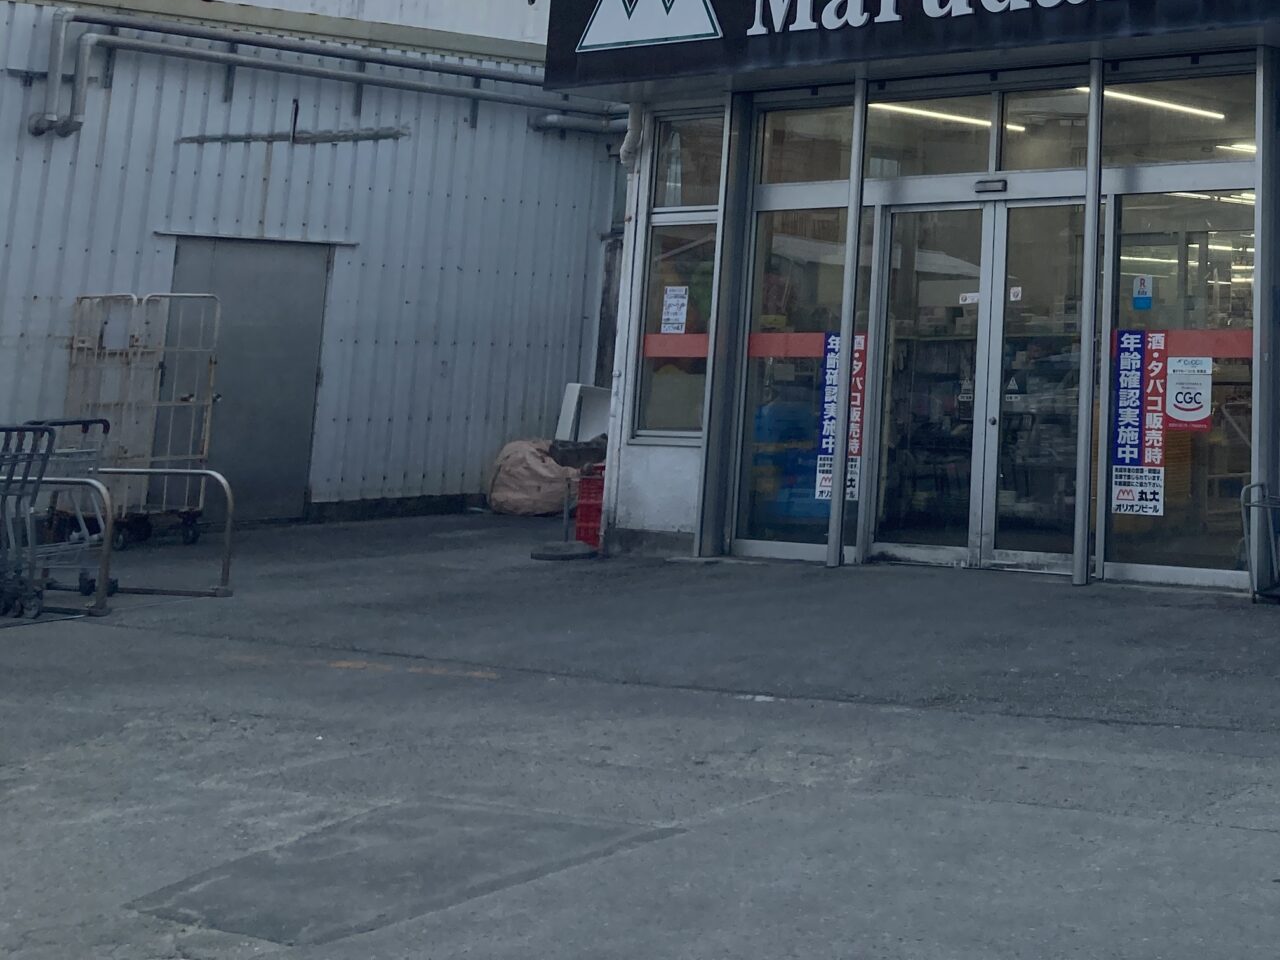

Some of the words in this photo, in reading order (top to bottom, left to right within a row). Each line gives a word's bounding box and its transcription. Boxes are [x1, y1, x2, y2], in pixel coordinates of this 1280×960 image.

[1117, 333, 1141, 464] 年齢確認実施中
[1144, 333, 1165, 464] 酒・タバコ販売時
[1175, 391, 1202, 404] CGC
[1115, 504, 1160, 513] オリオンビール
